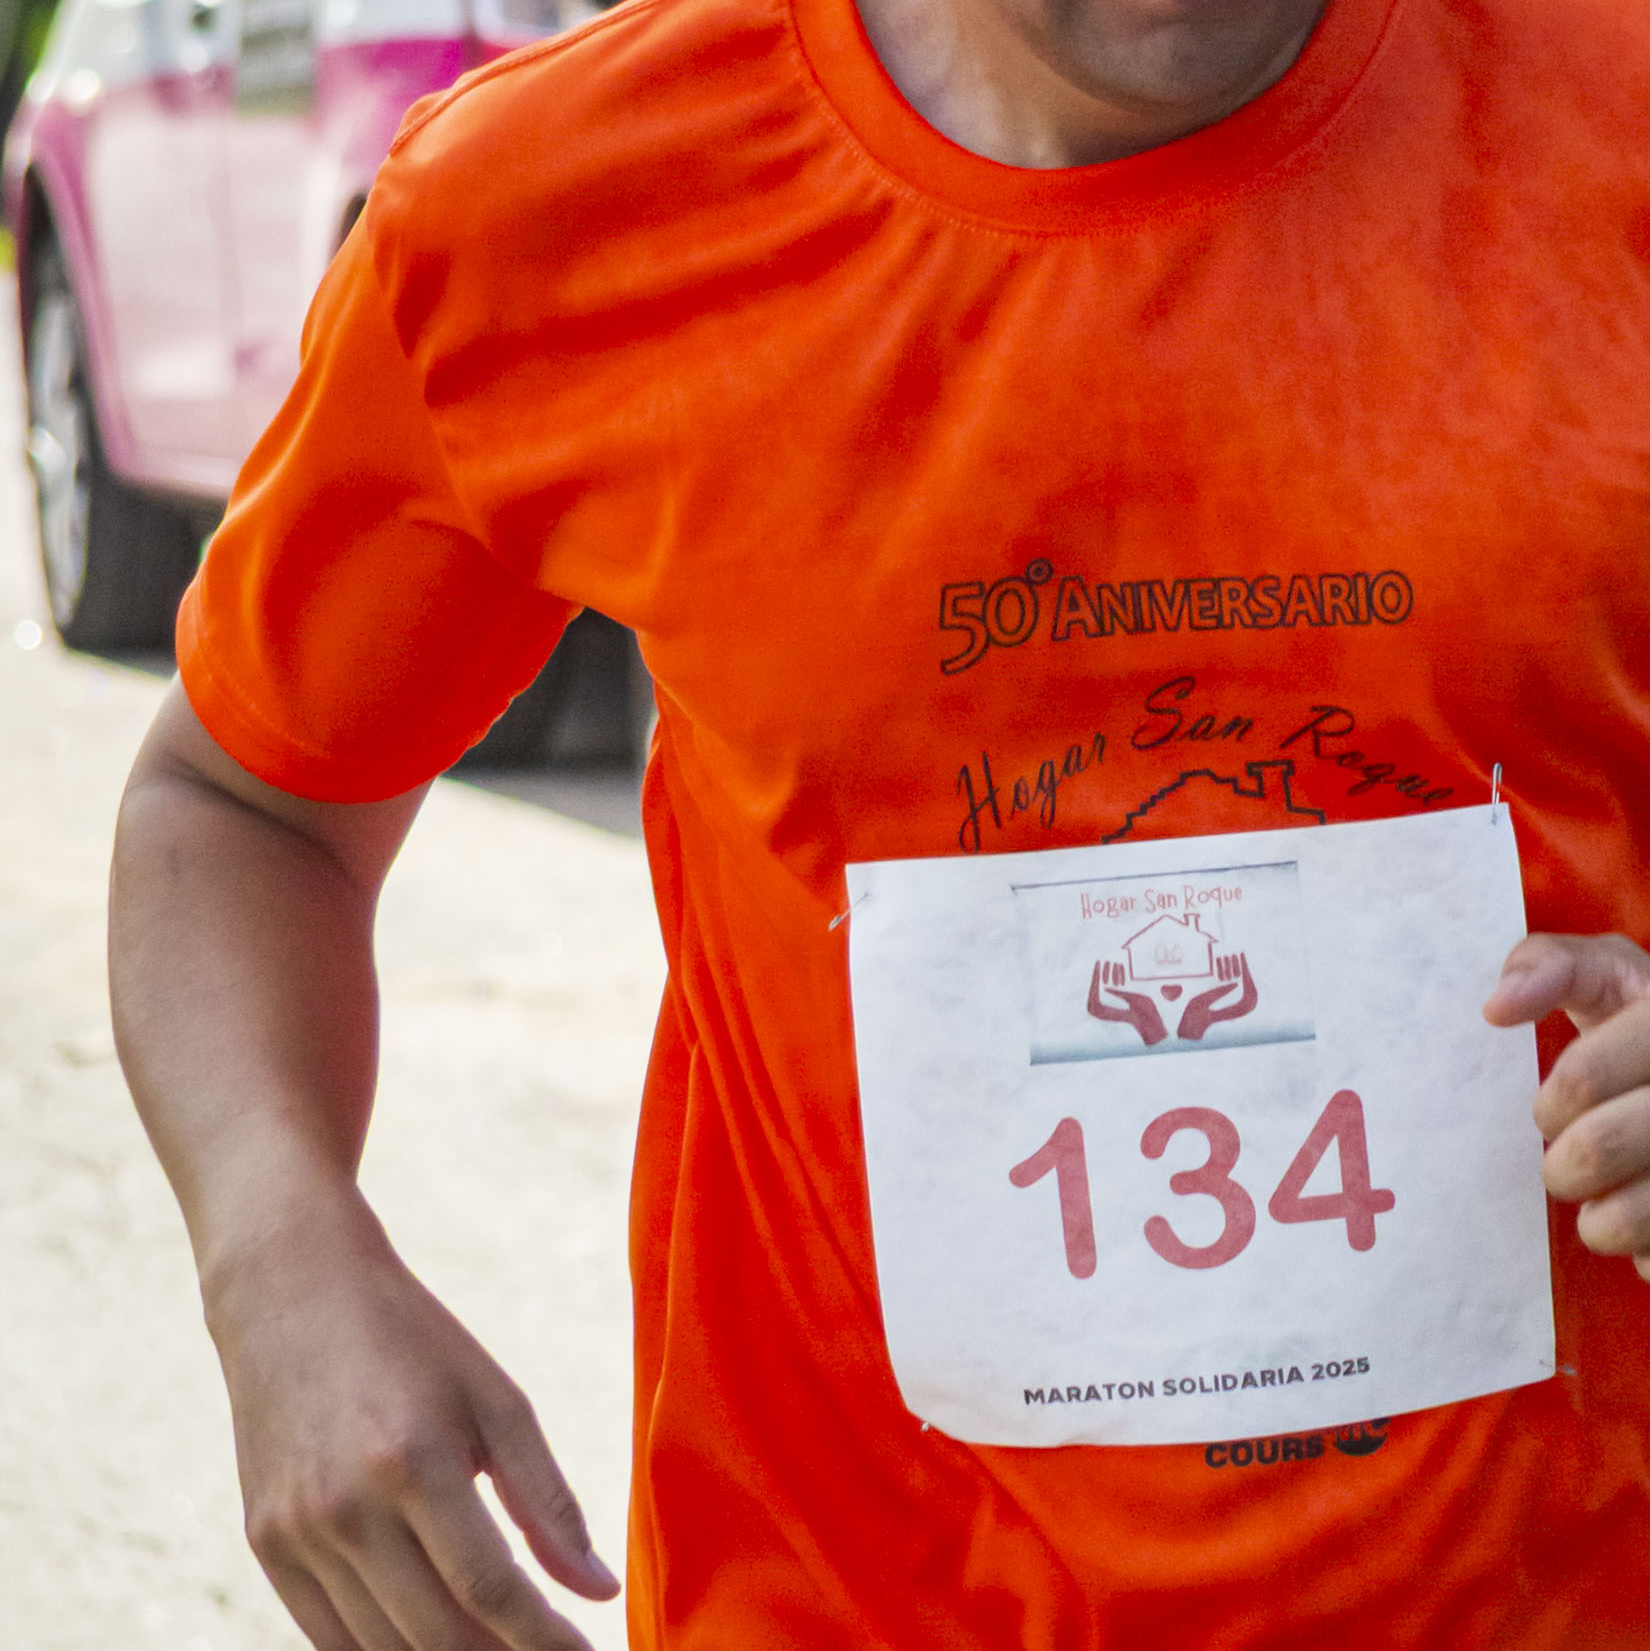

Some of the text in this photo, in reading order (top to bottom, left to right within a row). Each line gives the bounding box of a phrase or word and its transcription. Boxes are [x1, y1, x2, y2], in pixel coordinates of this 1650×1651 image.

[1052, 569, 1414, 642] ANIVERSARIO
[957, 676, 1455, 853] Hogar San Roque
[1080, 885, 1243, 919] Hogar San Roque
[1008, 1088, 1396, 1279] 134
[1023, 1356, 1371, 1405] MARATON SOLIDARIA 2025
[1205, 1435, 1325, 1468] COURS
